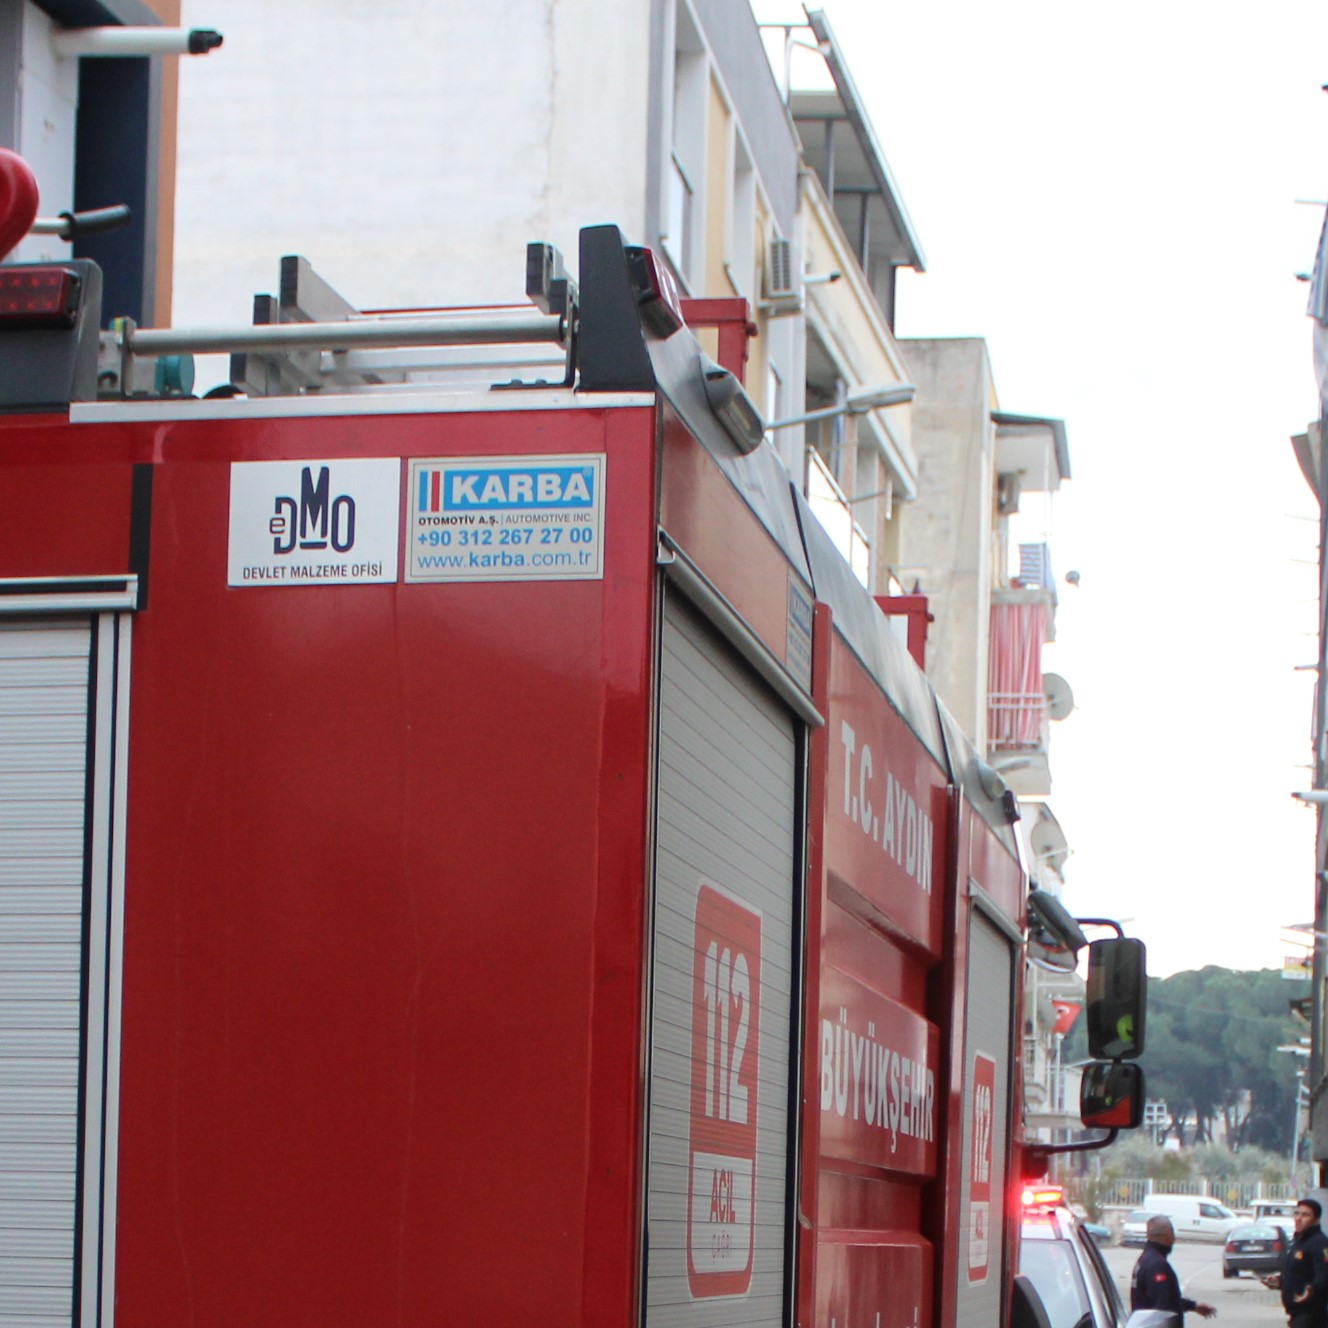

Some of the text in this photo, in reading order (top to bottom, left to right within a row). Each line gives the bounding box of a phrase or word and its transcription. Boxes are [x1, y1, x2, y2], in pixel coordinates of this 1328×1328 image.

[451, 472, 591, 505] KARBA
[418, 512, 593, 527] OTOMOTİV A.Ş. AUTOMOTIVE INC.
[418, 527, 593, 547] +90 312 267 27 00
[242, 560, 383, 580] DEVLET MALZEME OFİSİ
[417, 549, 593, 569] www.karba.com.tr
[840, 719, 934, 897] T.C. AYDIN
[704, 940, 750, 1125] 112
[820, 1006, 935, 1154] BÜYÜKŞEHİR
[973, 1083, 991, 1183] 112
